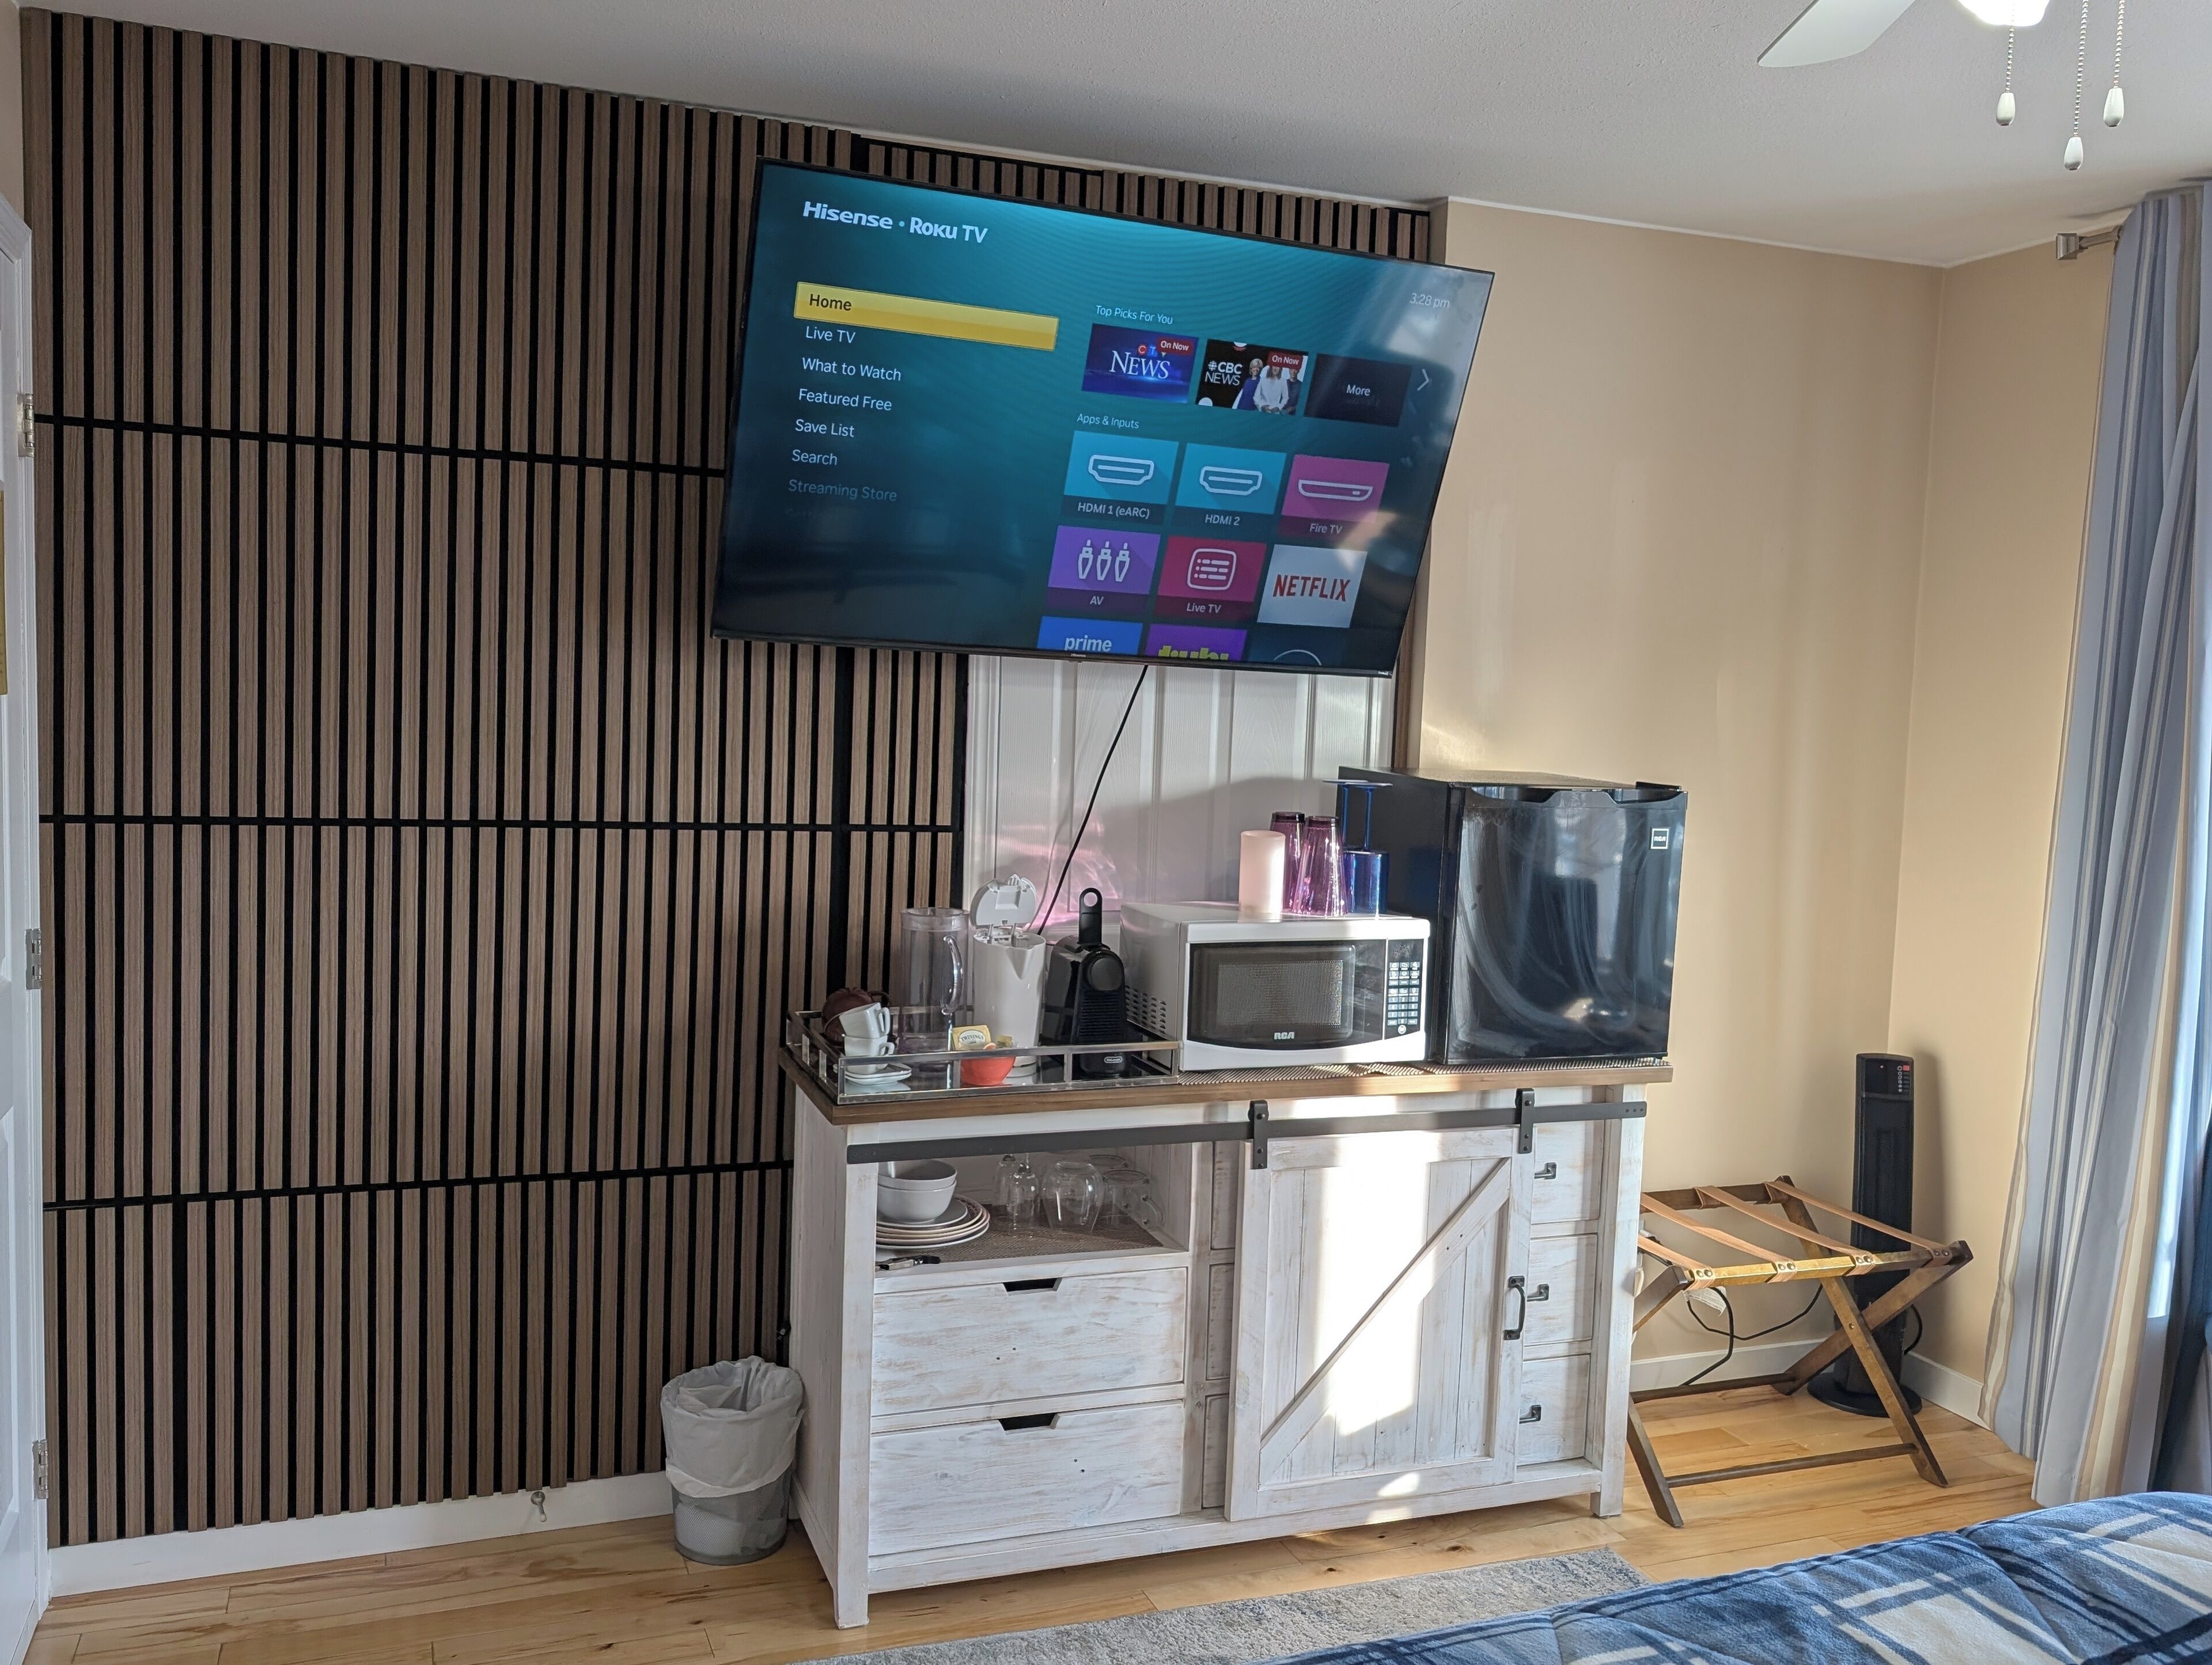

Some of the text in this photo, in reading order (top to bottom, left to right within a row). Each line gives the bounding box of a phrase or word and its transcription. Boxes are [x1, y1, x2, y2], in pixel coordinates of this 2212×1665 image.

[803, 202, 988, 243] Hisense Roku TV
[809, 294, 851, 311] Home
[1433, 298, 1450, 308] pm
[1096, 305, 1173, 324] Top Picks For You
[806, 326, 856, 343] Live TV
[1161, 340, 1190, 351] On Now
[1109, 350, 1171, 379] NEWS
[1218, 362, 1243, 374] CBC
[1272, 355, 1299, 365] On Now
[802, 357, 902, 381] What to Watch
[1205, 371, 1241, 386] NEWS
[1346, 384, 1370, 396] More
[798, 388, 892, 411] Featured Free
[795, 419, 855, 437] Save List
[1077, 414, 1139, 428] Apps & Inputs
[791, 449, 838, 465] Search
[788, 479, 897, 501] Streaming Store
[1078, 502, 1150, 519] HDMI 1 (eARC)
[1205, 514, 1240, 525] HDMI 2
[1309, 523, 1343, 534] Fire TV
[1272, 574, 1350, 601] NETFLIX
[1090, 596, 1104, 605] AV
[1186, 602, 1222, 613] Live TV
[1065, 635, 1112, 652] prime
[1274, 1031, 1295, 1040] RCA
